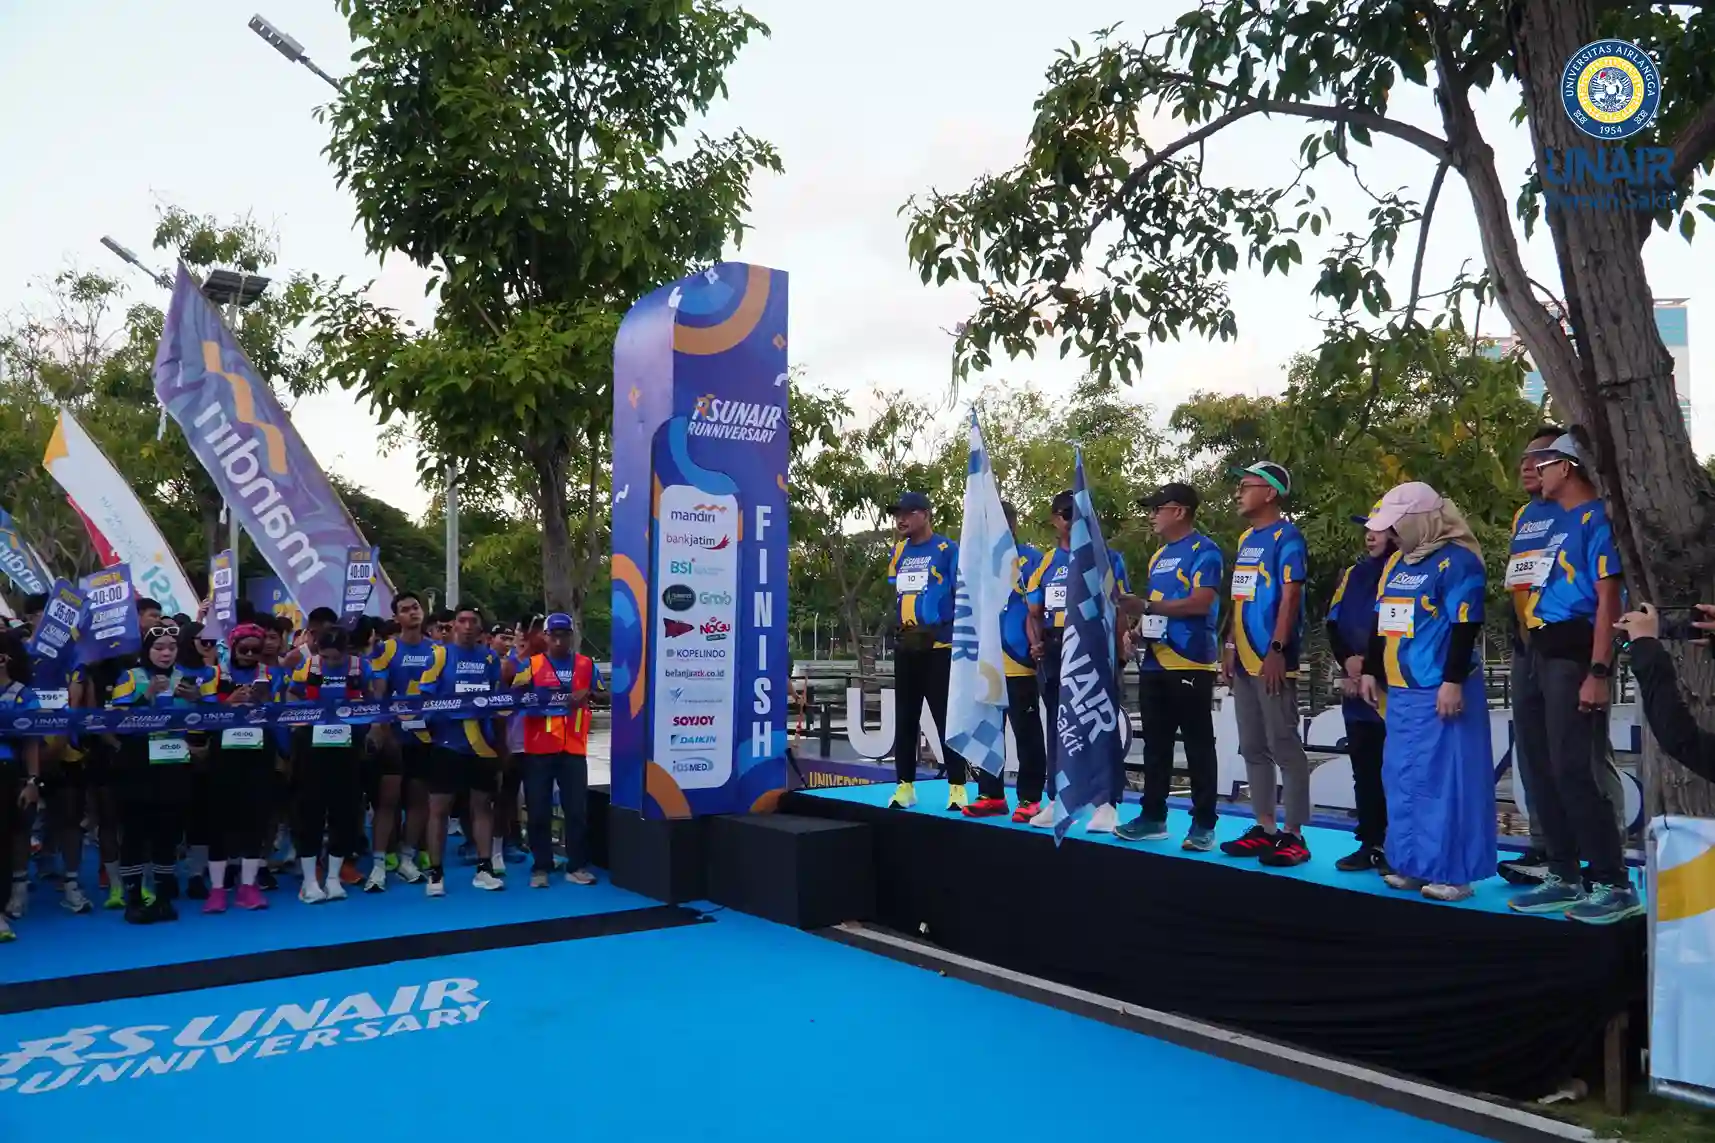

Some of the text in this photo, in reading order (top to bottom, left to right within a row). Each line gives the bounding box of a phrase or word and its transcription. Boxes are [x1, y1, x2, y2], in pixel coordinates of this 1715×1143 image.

[687, 421, 776, 443] RUNNIVERSARY
[670, 509, 716, 523] mandiri
[666, 533, 716, 546] bankjatim
[670, 560, 693, 574] BSI
[1390, 607, 1396, 618] 5
[753, 505, 773, 758] FINISH
[676, 649, 726, 658] KOPELINDO
[1060, 624, 1117, 744] NAIR
[672, 716, 716, 726] SOYJOY
[680, 735, 717, 744] DAIKIN
